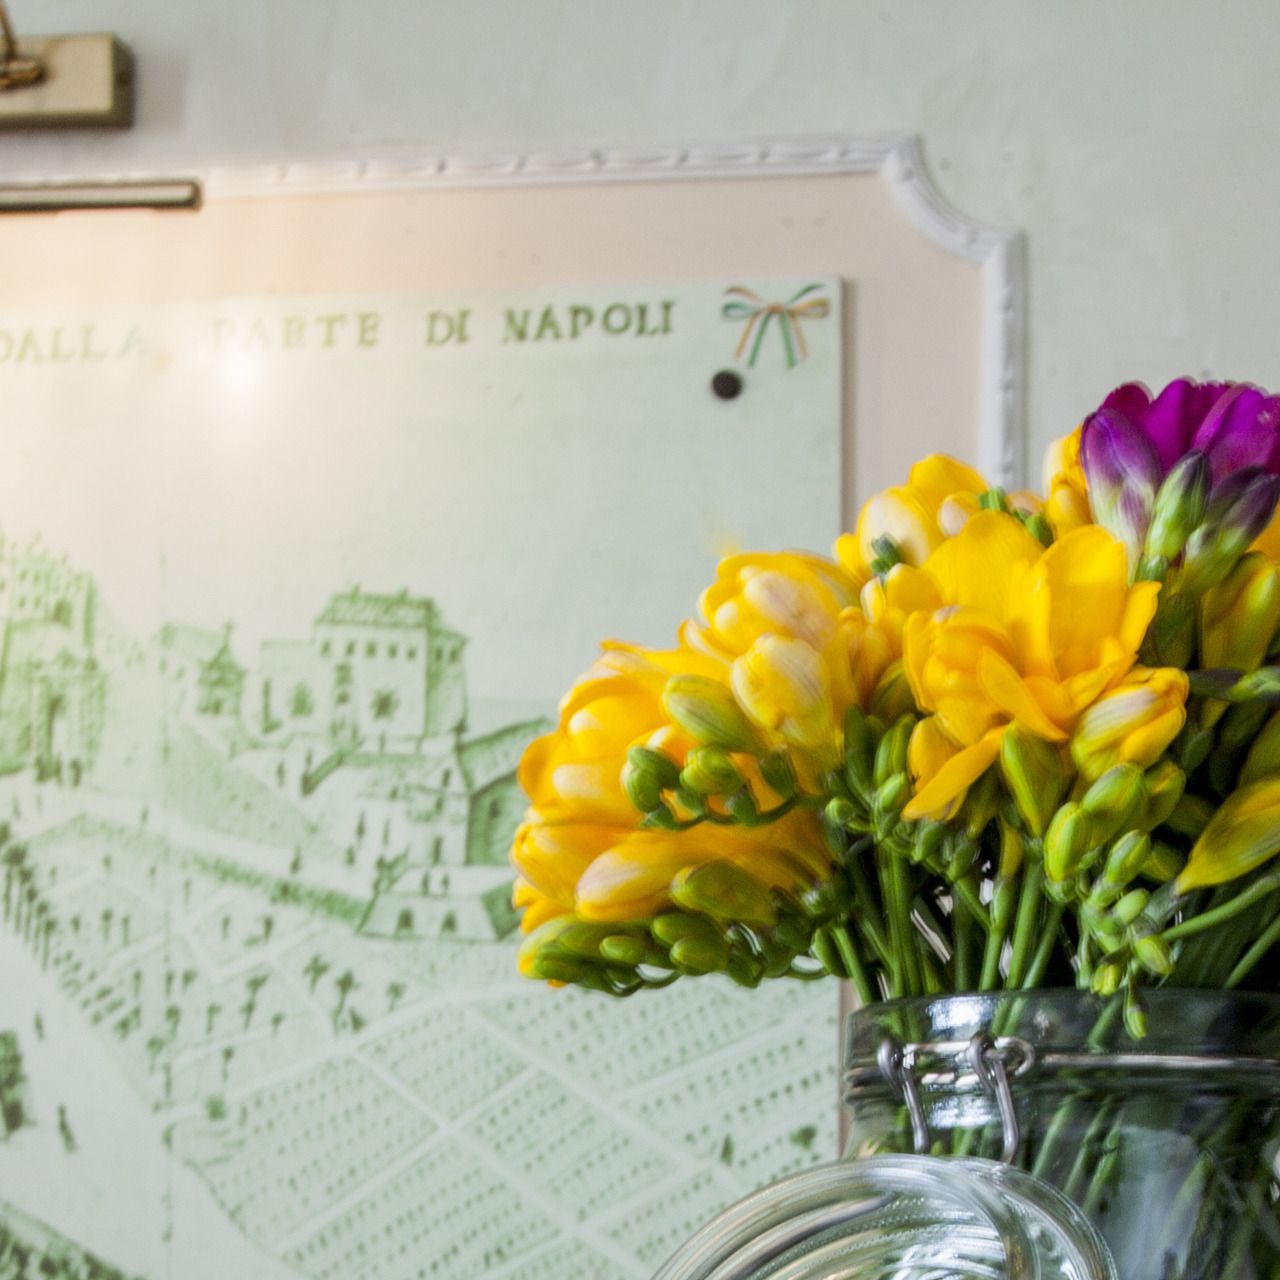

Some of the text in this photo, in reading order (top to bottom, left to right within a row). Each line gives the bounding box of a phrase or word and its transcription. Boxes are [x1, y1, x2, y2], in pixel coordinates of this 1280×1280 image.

[211, 310, 382, 352] PARTE
[426, 308, 472, 346] DI
[501, 299, 677, 344] NAPOLI
